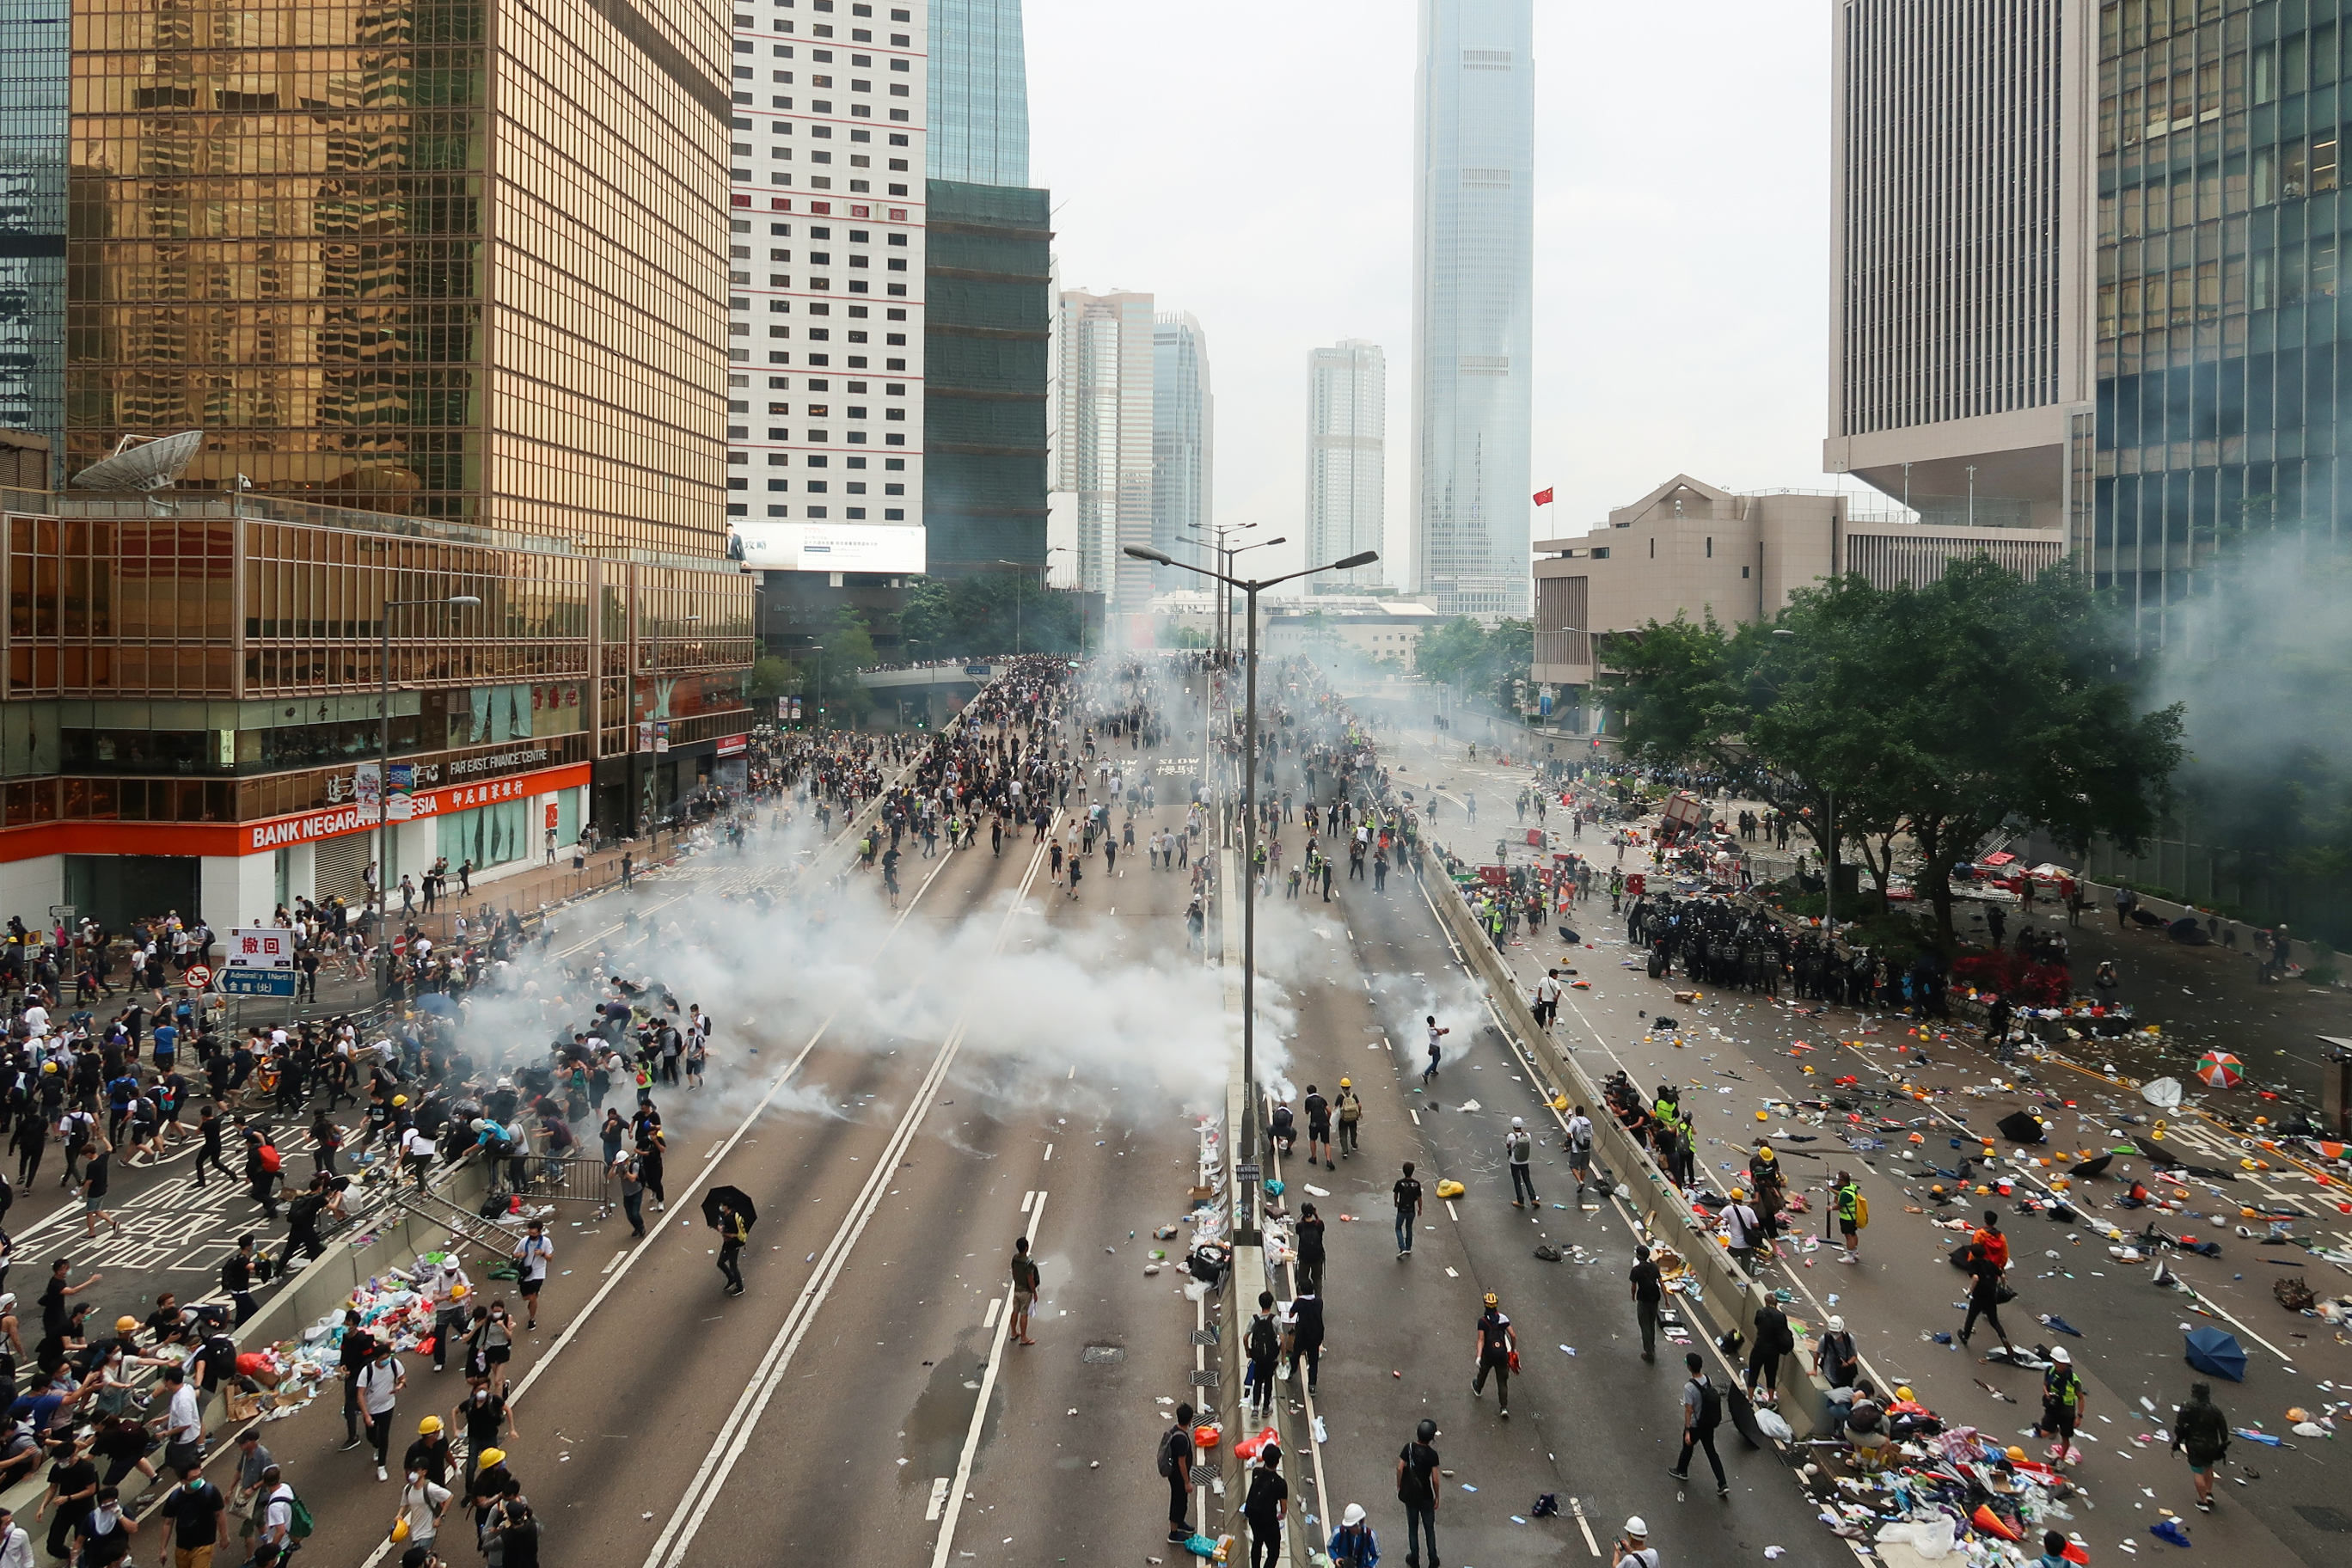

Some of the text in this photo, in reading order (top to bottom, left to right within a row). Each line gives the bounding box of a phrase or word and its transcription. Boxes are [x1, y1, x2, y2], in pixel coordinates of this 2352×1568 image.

[744, 540, 767, 550] 攻略
[450, 749, 547, 775] FAR EAST FINANCE CENTRE
[1156, 764, 1197, 776] 慢駛
[452, 780, 523, 808] 印尼國家銀行
[252, 820, 300, 848] BANK
[242, 936, 280, 954] 撤回
